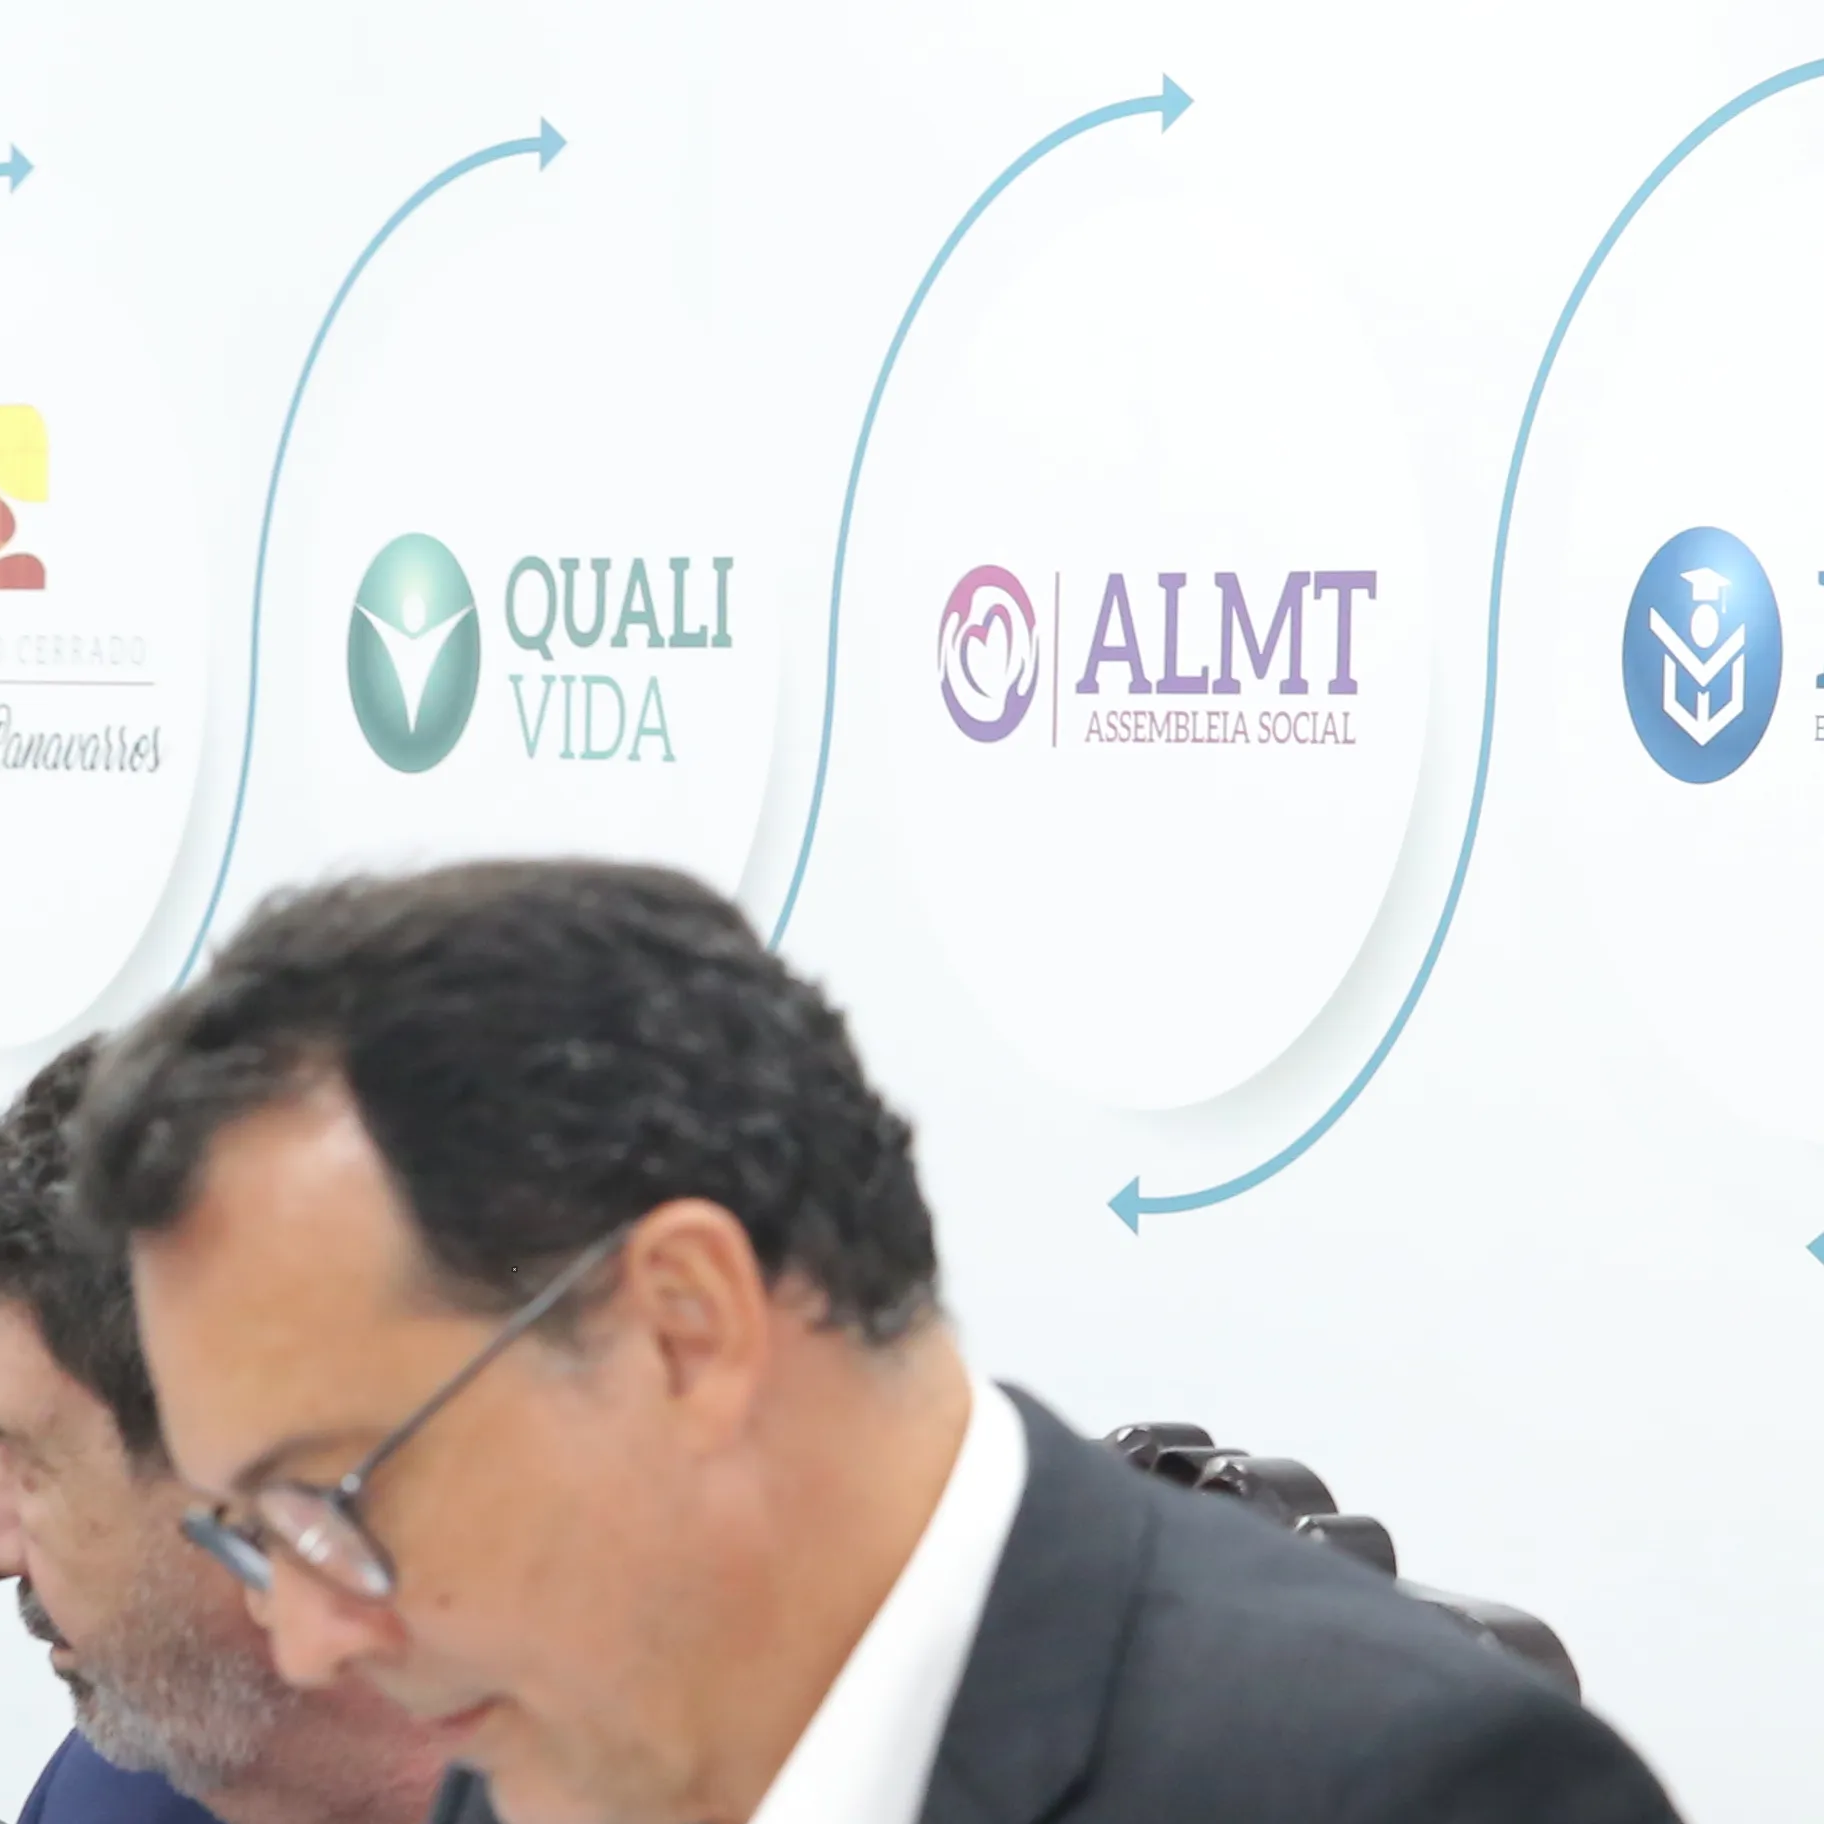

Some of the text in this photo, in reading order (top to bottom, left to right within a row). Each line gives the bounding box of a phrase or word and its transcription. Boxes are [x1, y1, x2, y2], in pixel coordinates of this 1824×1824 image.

[17, 634, 148, 667] CERRADO
[505, 555, 734, 661] QUALI
[1075, 570, 1378, 695] ALMT
[508, 673, 677, 763] VIDA
[1084, 710, 1357, 745] ASSEMBLEIA SOCIAL
